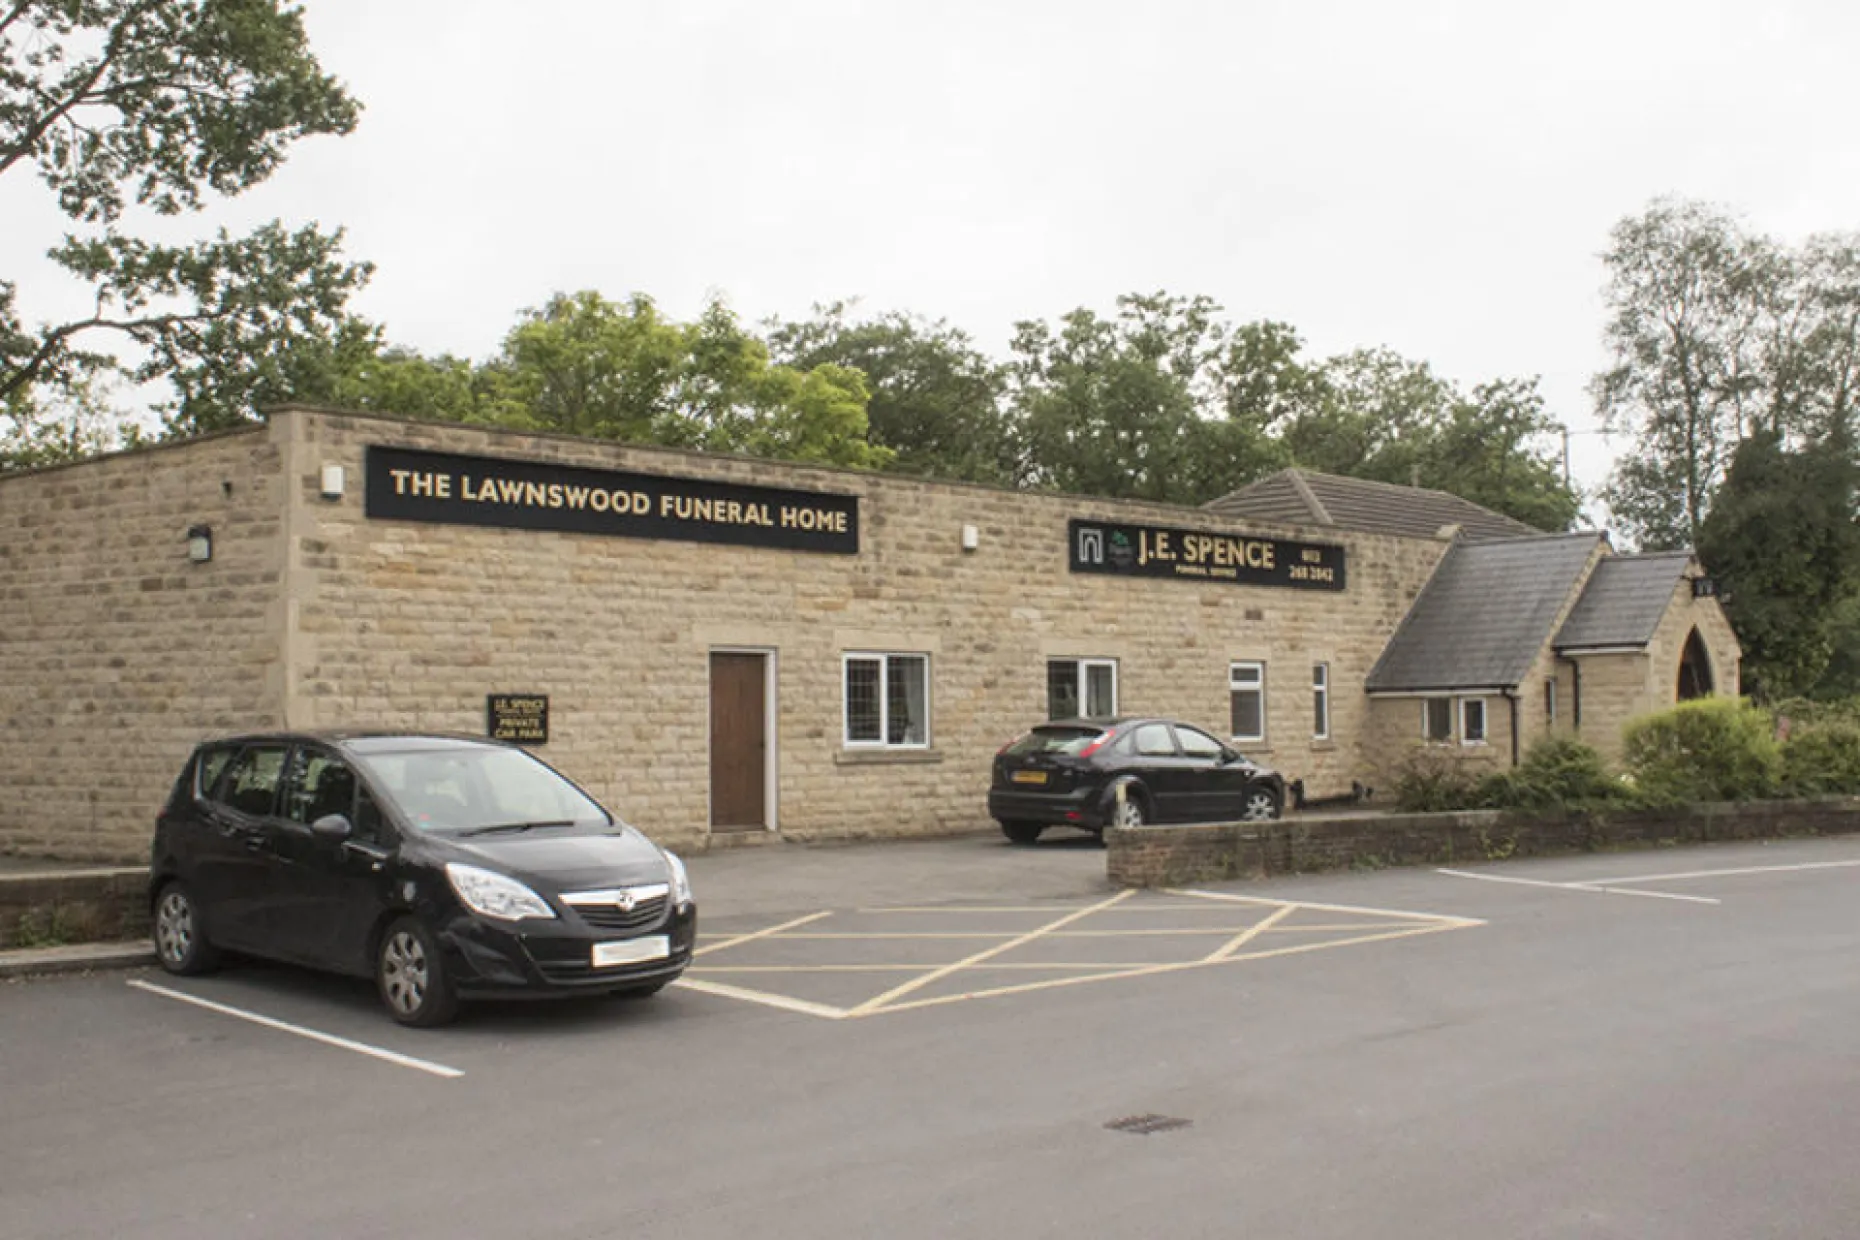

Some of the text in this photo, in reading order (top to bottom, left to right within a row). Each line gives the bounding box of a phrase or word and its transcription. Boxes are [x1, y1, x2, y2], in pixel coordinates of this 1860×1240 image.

[390, 468, 848, 532] THE LAWNSWOOD FUNERAL HOME
[1137, 530, 1275, 569] J.E. SPENCE
